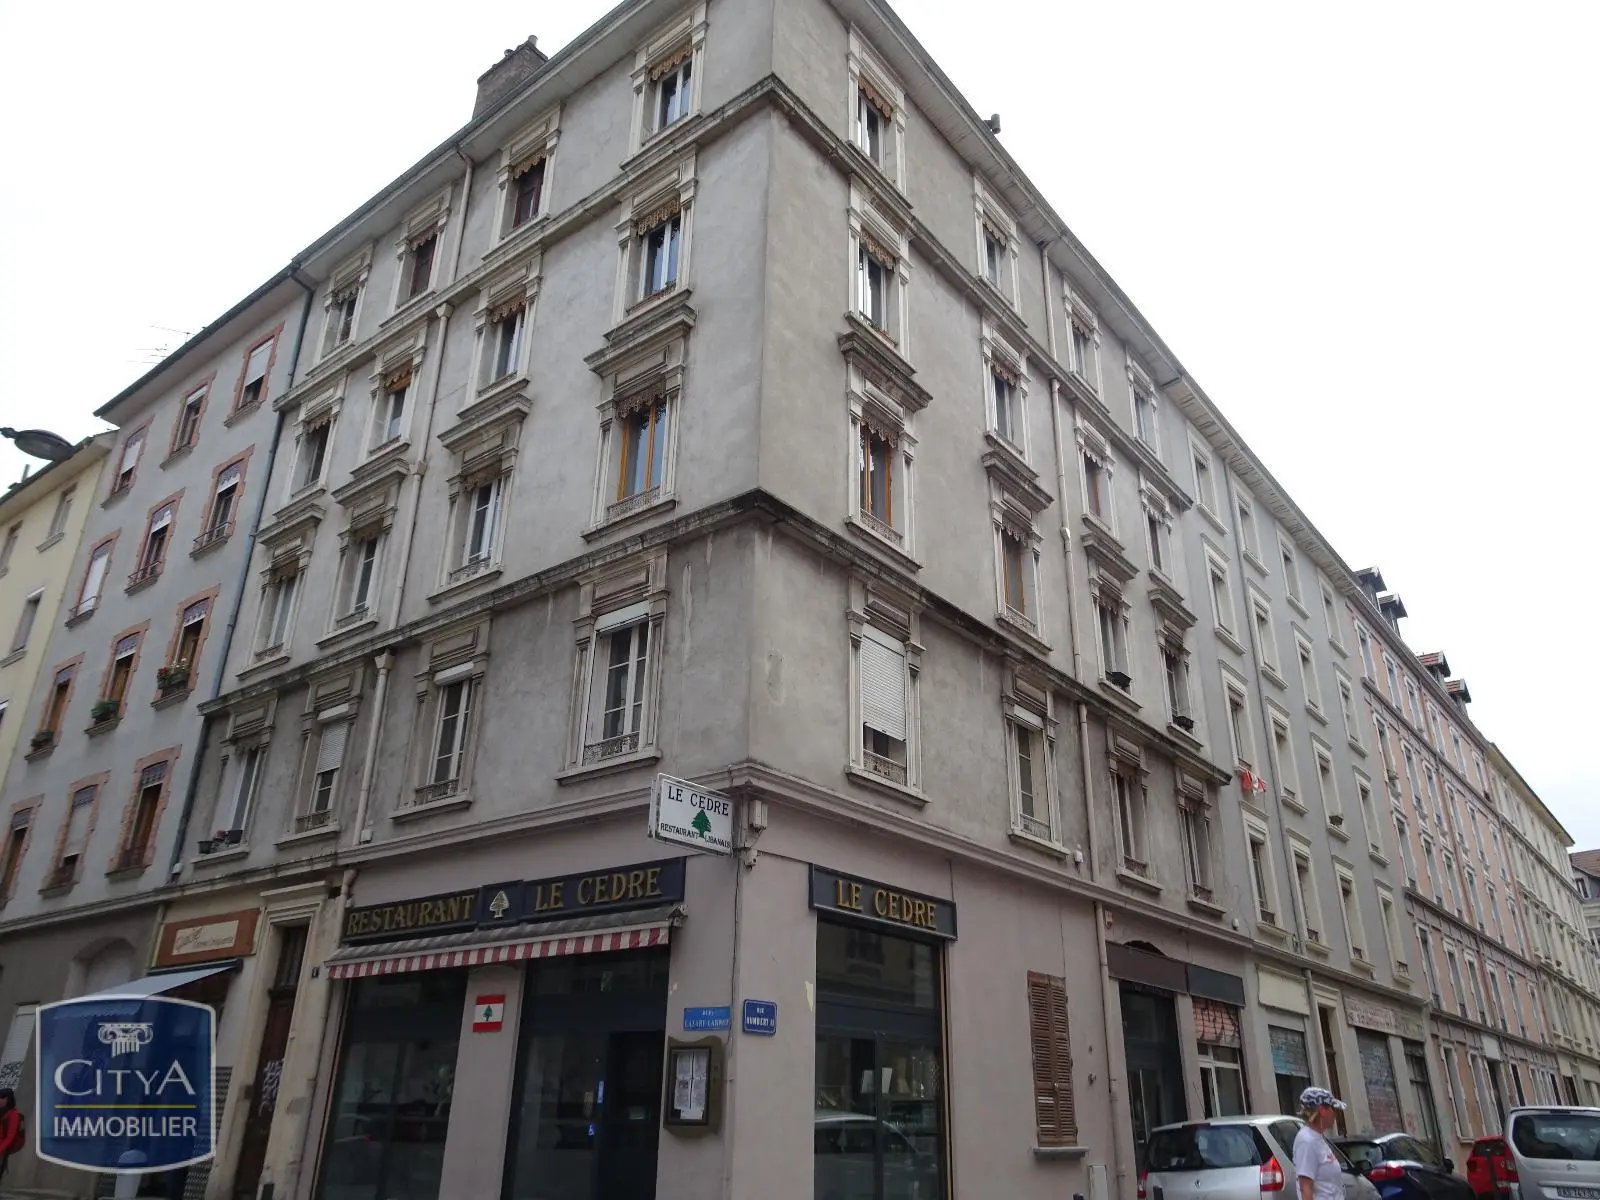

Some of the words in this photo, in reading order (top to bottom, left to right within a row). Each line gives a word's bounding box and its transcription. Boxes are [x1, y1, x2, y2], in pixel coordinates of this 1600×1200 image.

[668, 785, 683, 802] LE
[690, 793, 729, 816] CEDRE
[660, 822, 699, 839] RESTAURANT
[704, 835, 731, 849] LIBANAIS
[346, 893, 476, 936] RESTAURANT
[536, 883, 563, 909] LE
[577, 867, 663, 906] CEDRE
[836, 878, 862, 909] LE
[874, 889, 937, 928] CEDRE
